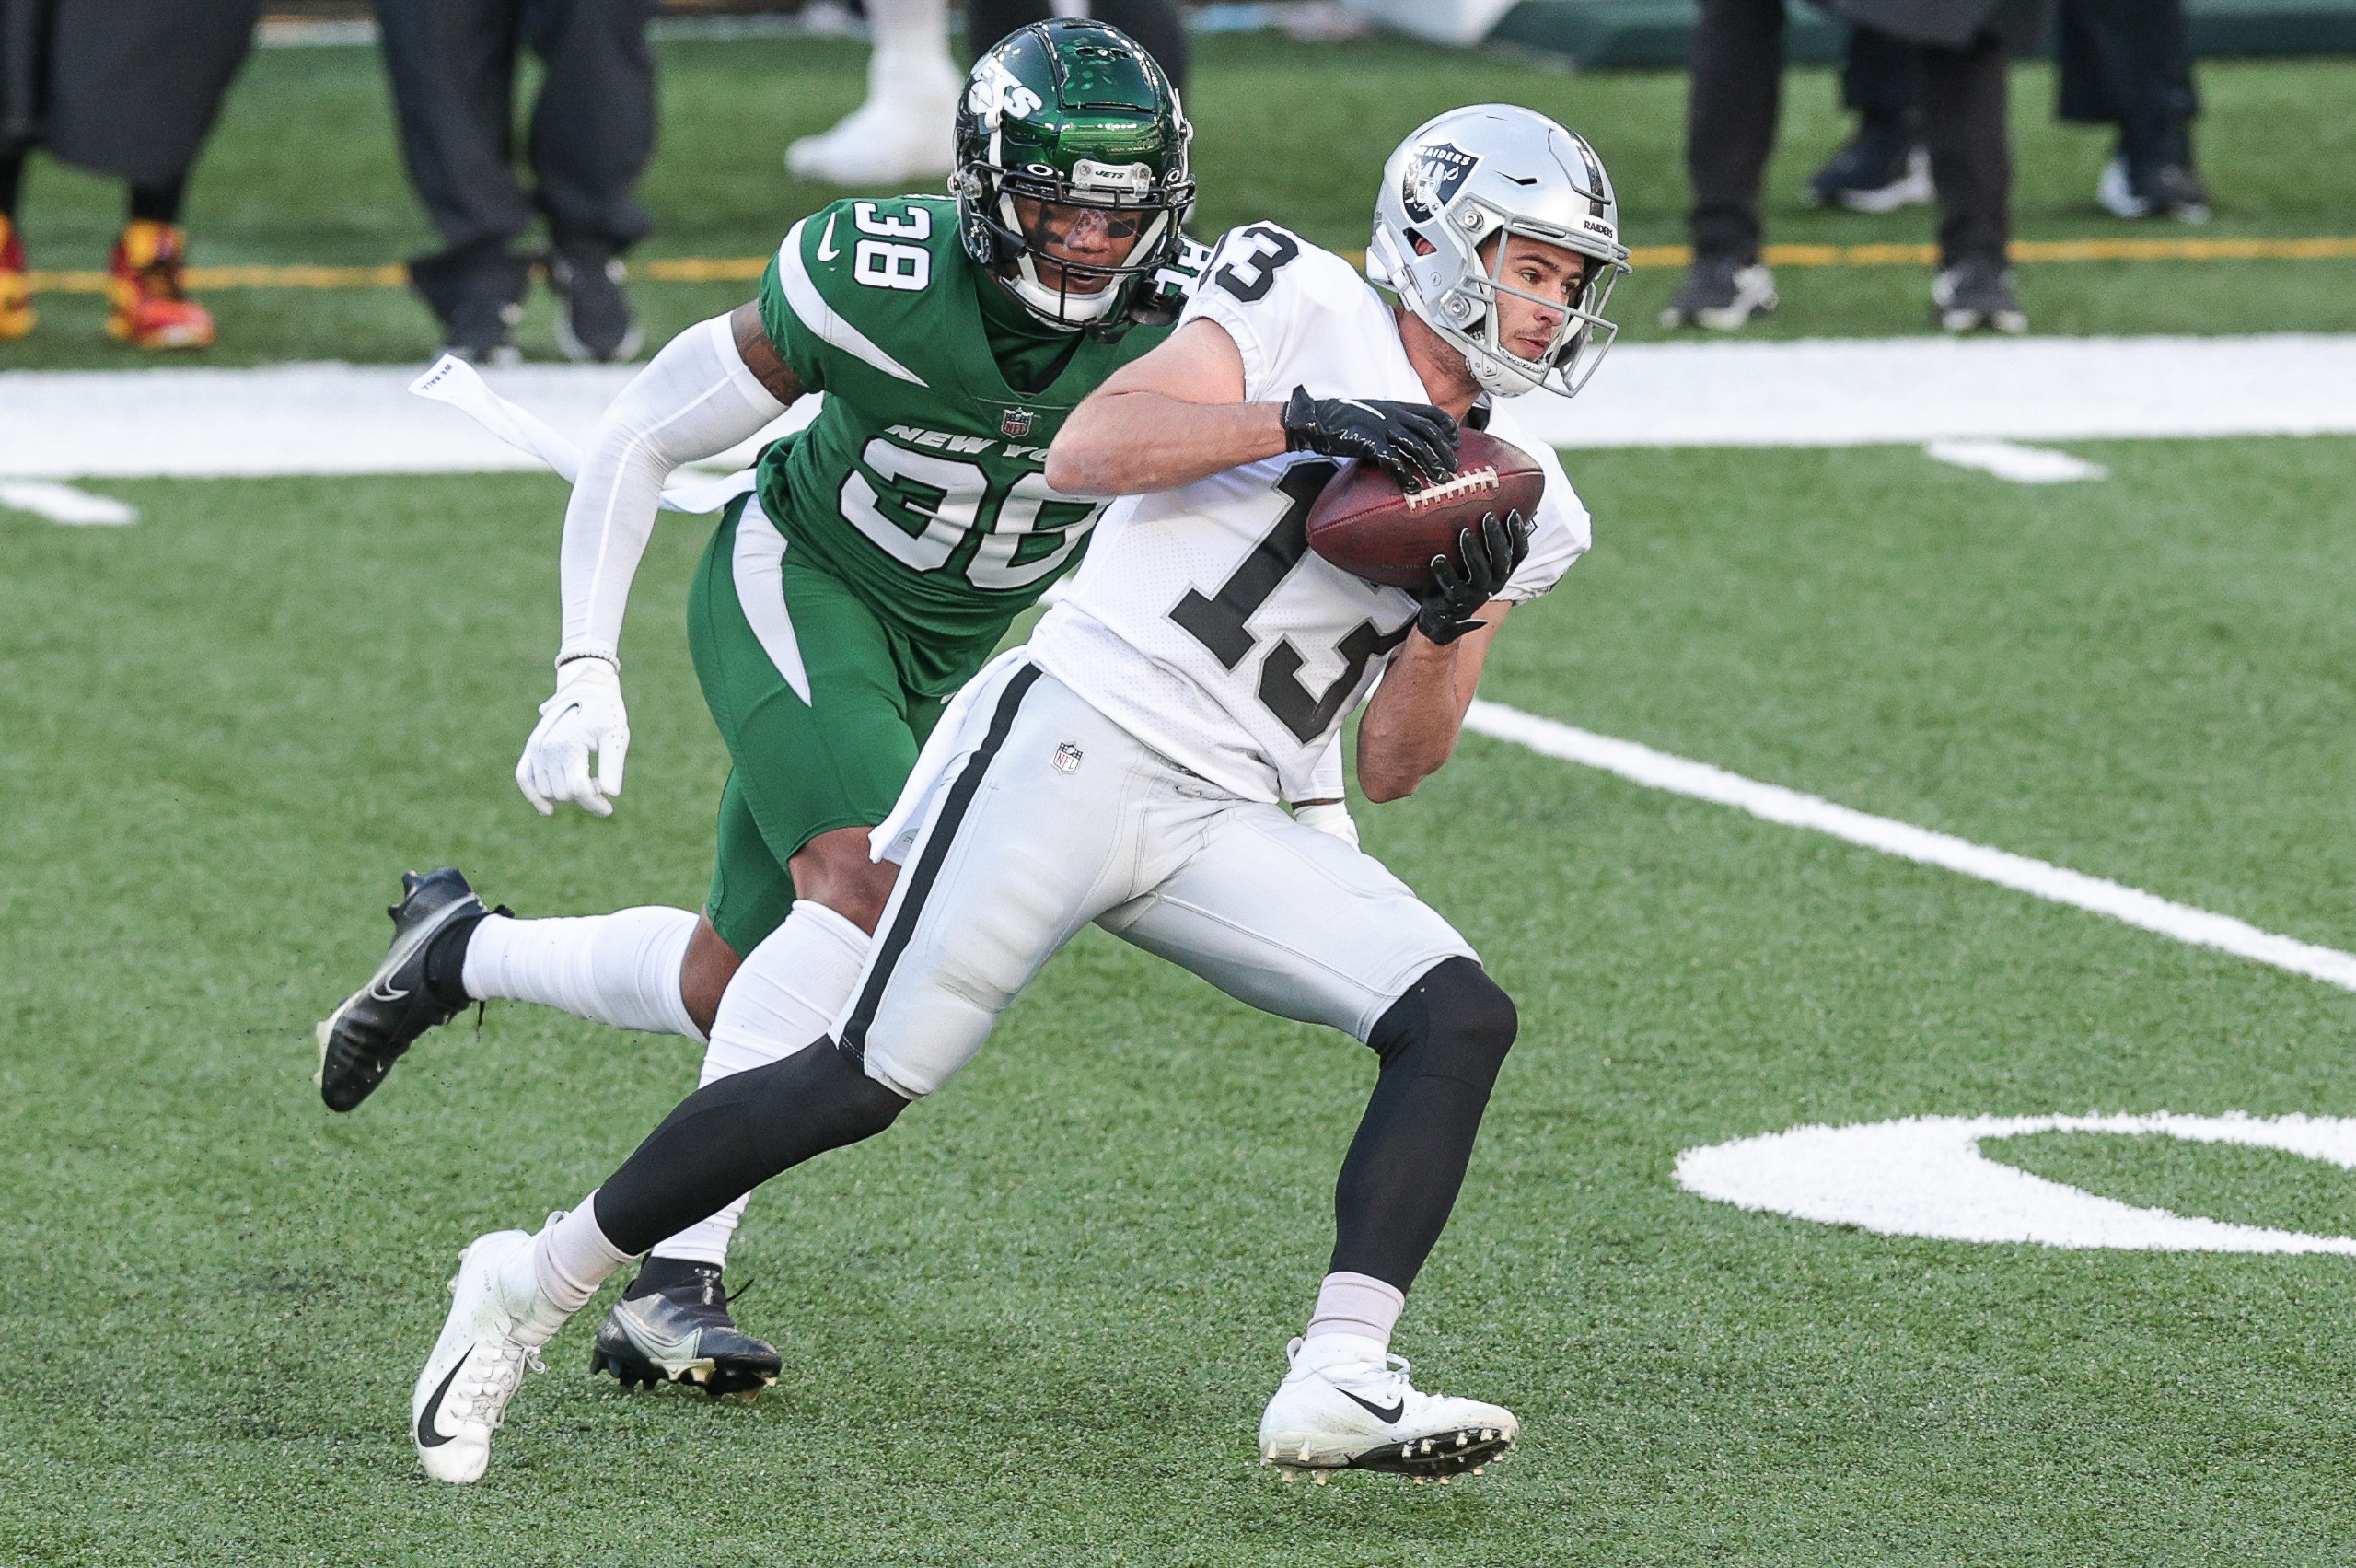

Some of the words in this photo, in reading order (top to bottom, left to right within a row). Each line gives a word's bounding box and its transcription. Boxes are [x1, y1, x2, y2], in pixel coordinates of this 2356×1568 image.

[1095, 170, 1125, 180] JETS
[853, 199, 932, 292] 38
[884, 424, 999, 455] NEW
[838, 437, 1119, 589] 38
[1160, 458, 1423, 747] 13
